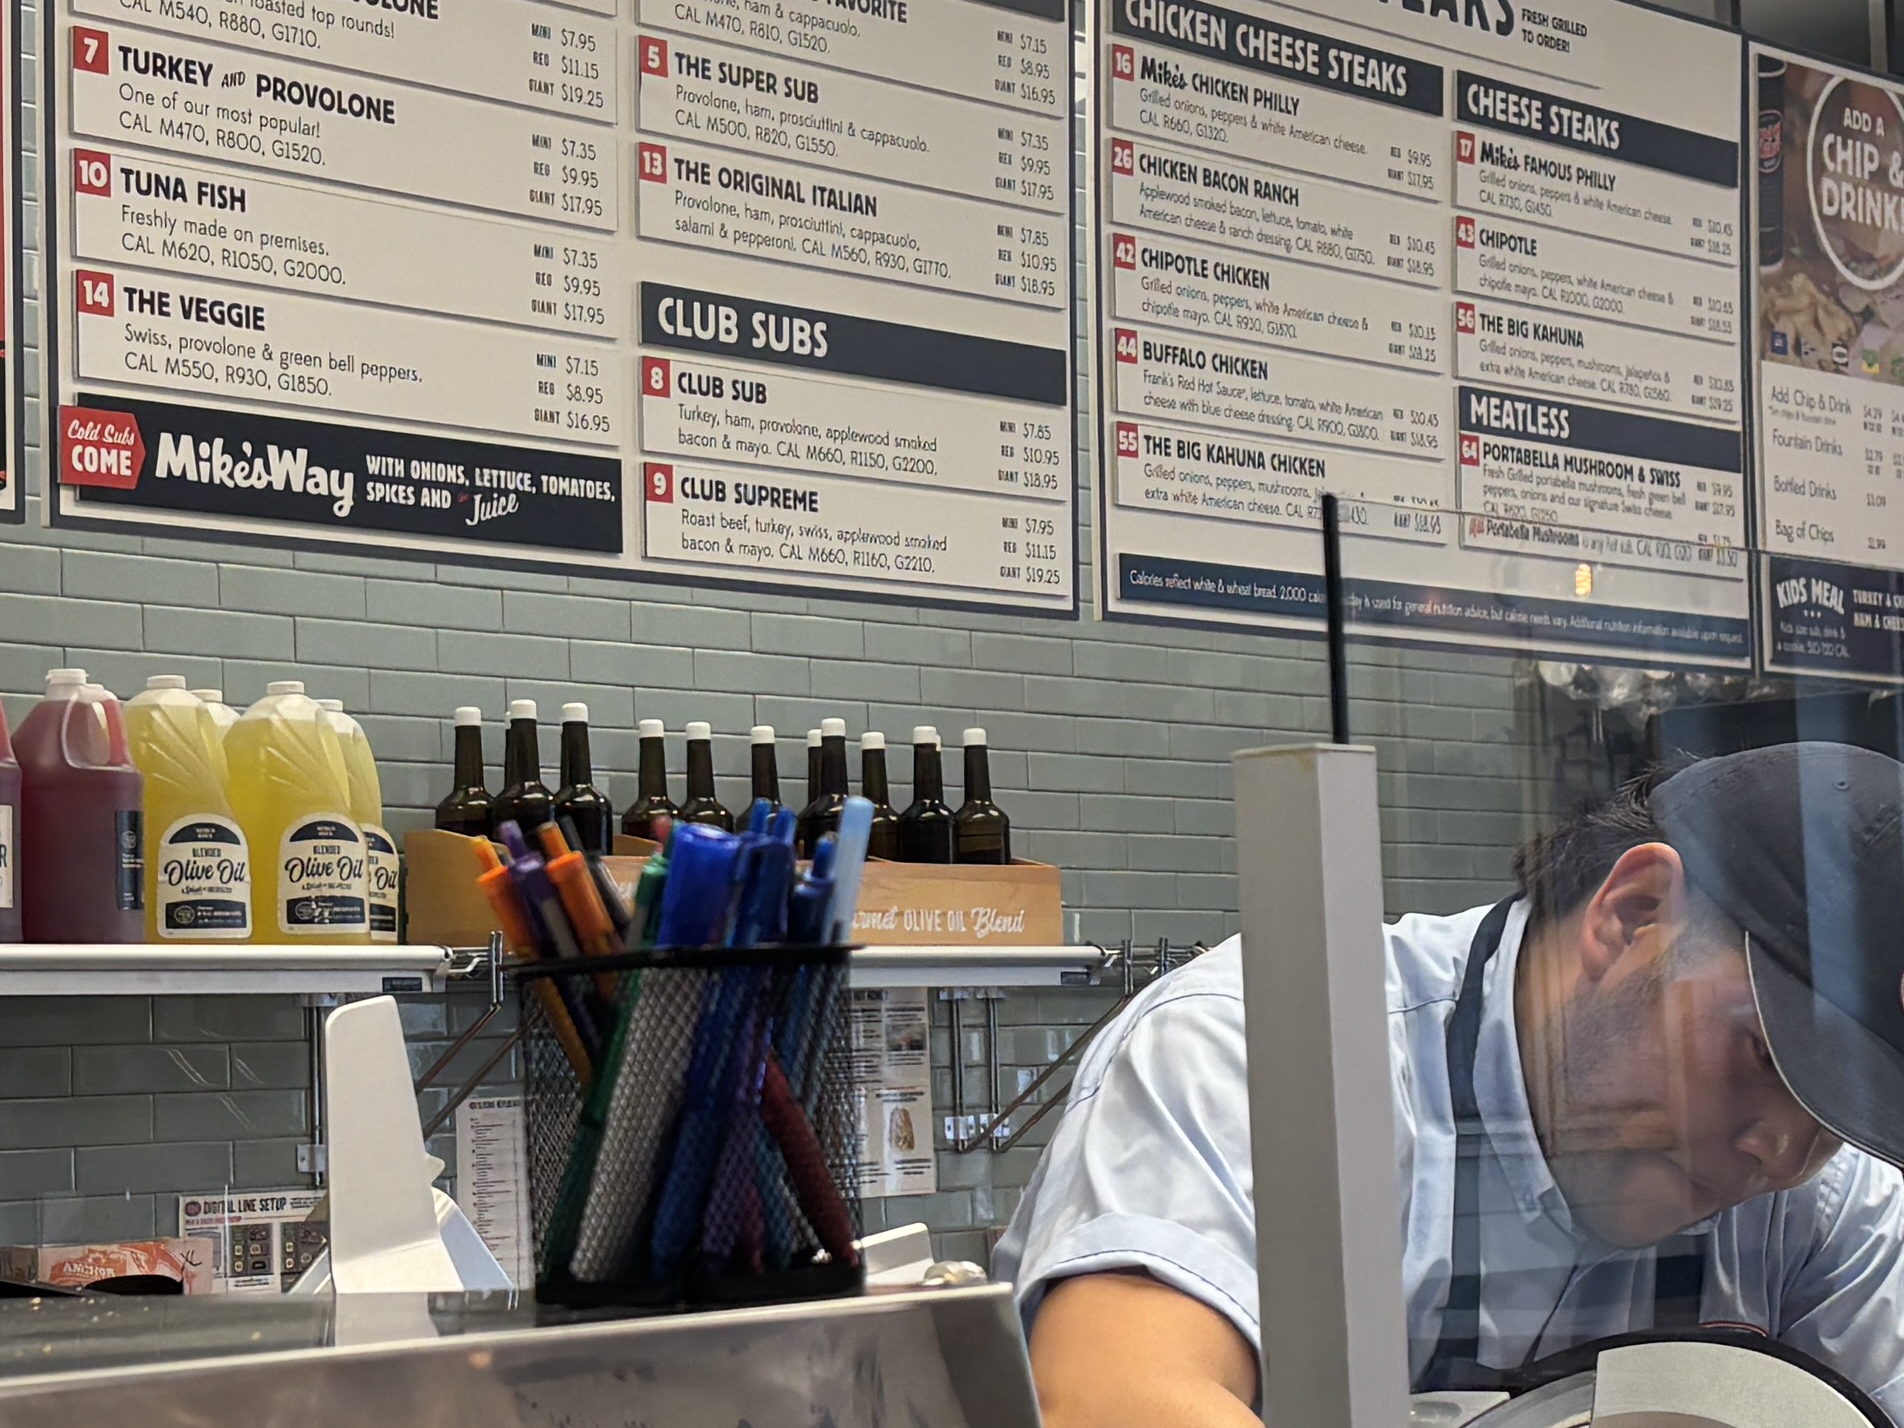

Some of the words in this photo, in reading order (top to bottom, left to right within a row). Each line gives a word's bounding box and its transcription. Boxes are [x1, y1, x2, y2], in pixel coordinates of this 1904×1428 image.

[83, 37, 98, 63] 7
[118, 45, 213, 88] TURKEY
[256, 75, 396, 124] PROVOLONE
[647, 46, 660, 67] 5
[675, 52, 712, 80] THE
[718, 62, 777, 96] SUPER
[784, 77, 820, 104] SUB
[1116, 51, 1132, 74] 16
[1191, 72, 1249, 104] CHICKEN
[1253, 88, 1300, 116] PHILLY
[1235, 23, 1319, 76] CHEESE
[1328, 48, 1407, 97] STEAKS
[1467, 83, 1543, 131] CHEESE
[1549, 105, 1620, 150] STEAKS
[1843, 107, 1872, 133] ADD
[1875, 115, 1885, 138] A
[1113, 148, 1133, 169] 26
[1139, 152, 1198, 184] CHICKEN
[1203, 167, 1249, 195] BACON
[1254, 182, 1299, 207] RANCH
[1822, 133, 1880, 177] CHIP
[79, 160, 107, 187] 10
[120, 168, 187, 203] TUNA
[197, 181, 246, 213] FISH
[643, 151, 663, 175] 13
[674, 157, 711, 185] THE
[717, 167, 806, 205] ORIGINAL
[811, 186, 877, 218] ITALIAN
[82, 280, 110, 308] 14
[124, 286, 171, 319] THE
[179, 295, 266, 331] VEGGIE
[657, 297, 739, 344] CLUB
[751, 311, 829, 358] SUBS
[649, 369, 664, 390] 8
[677, 372, 724, 400] CLUB
[731, 380, 768, 404] SUB
[1470, 394, 1570, 440] MEATLESS
[71, 446, 132, 476] COME
[652, 474, 668, 496] 9
[680, 477, 727, 504] CLUB
[734, 483, 819, 513] SUPREME
[1776, 577, 1807, 608] KIDS
[1811, 578, 1845, 615] MEAL
[164, 857, 214, 886] Olive
